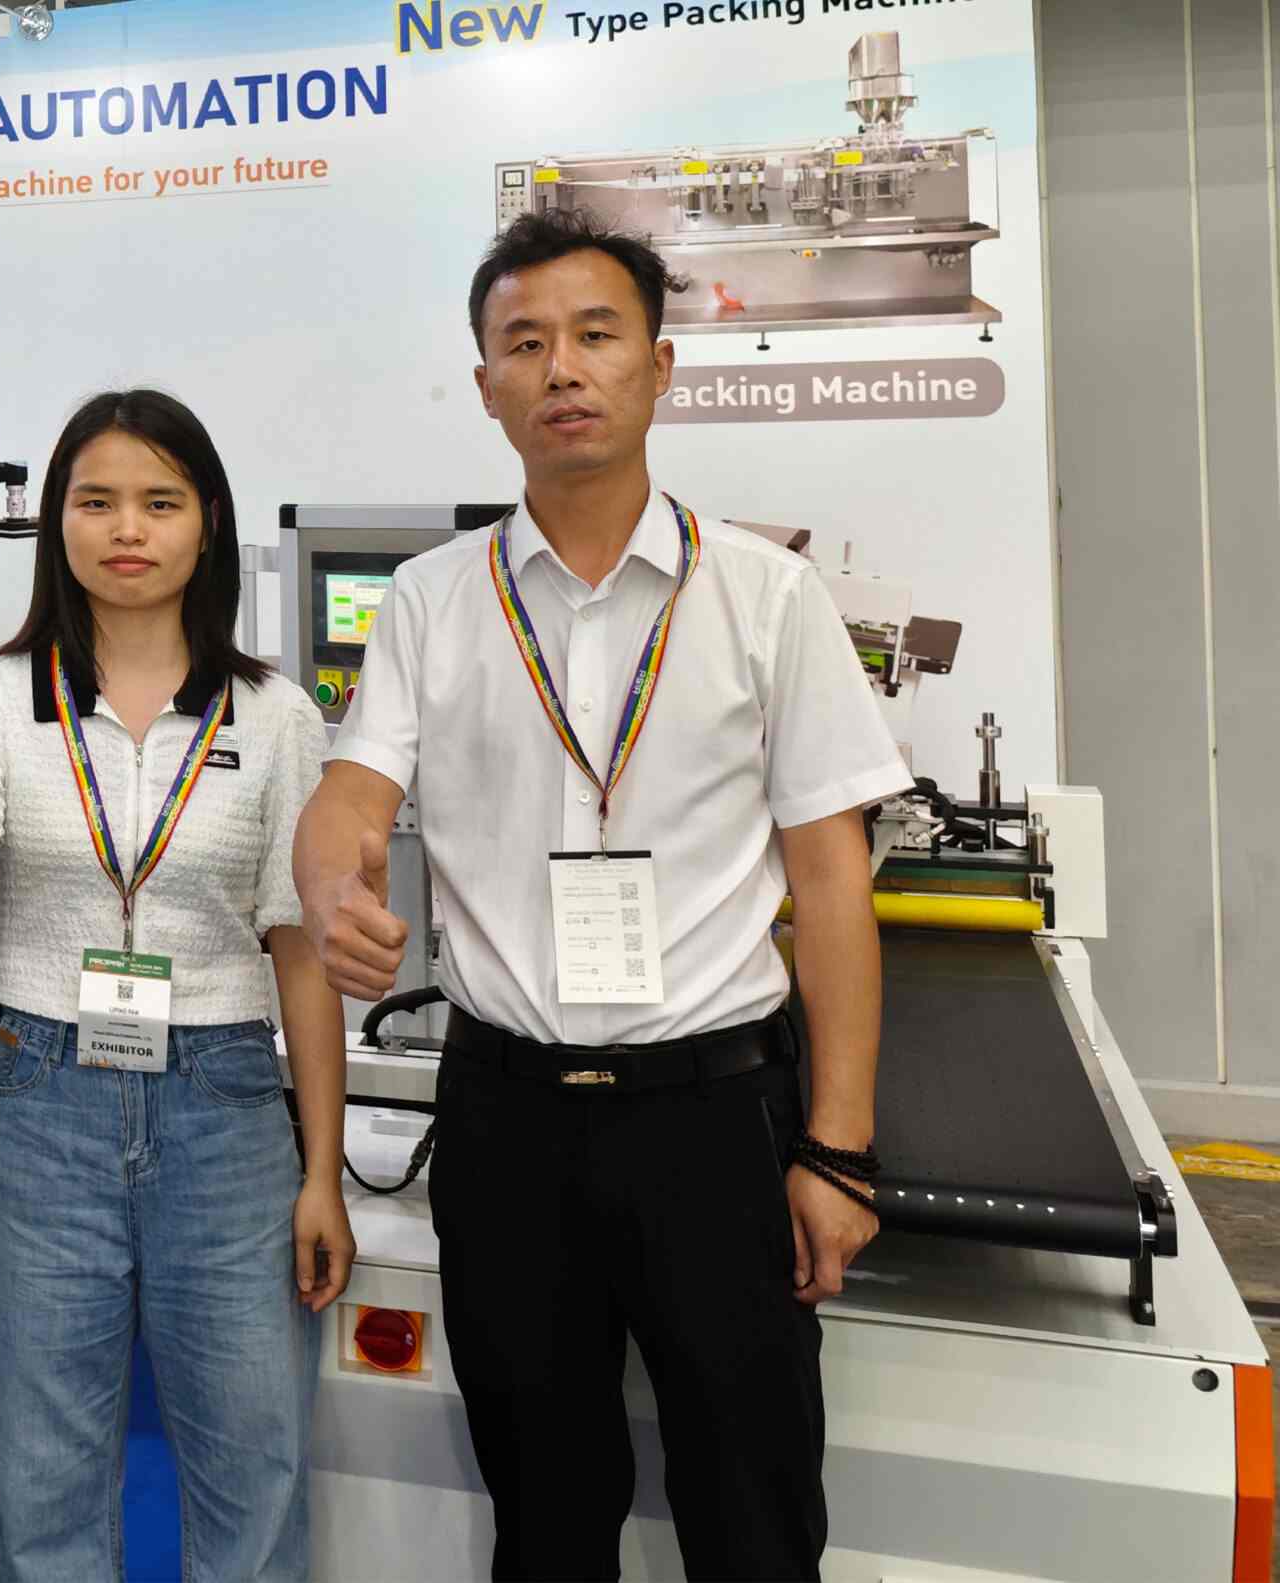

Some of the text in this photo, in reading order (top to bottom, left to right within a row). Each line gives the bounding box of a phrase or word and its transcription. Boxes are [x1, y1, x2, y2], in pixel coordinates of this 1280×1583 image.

[399, 1, 543, 52] New
[566, 12, 648, 43] Type
[663, 0, 805, 27] Packing
[103, 166, 144, 193] for
[153, 164, 224, 197] your
[233, 156, 329, 184] future
[672, 370, 977, 414] acking Machine
[91, 1040, 153, 1057] EXHIBITOR
